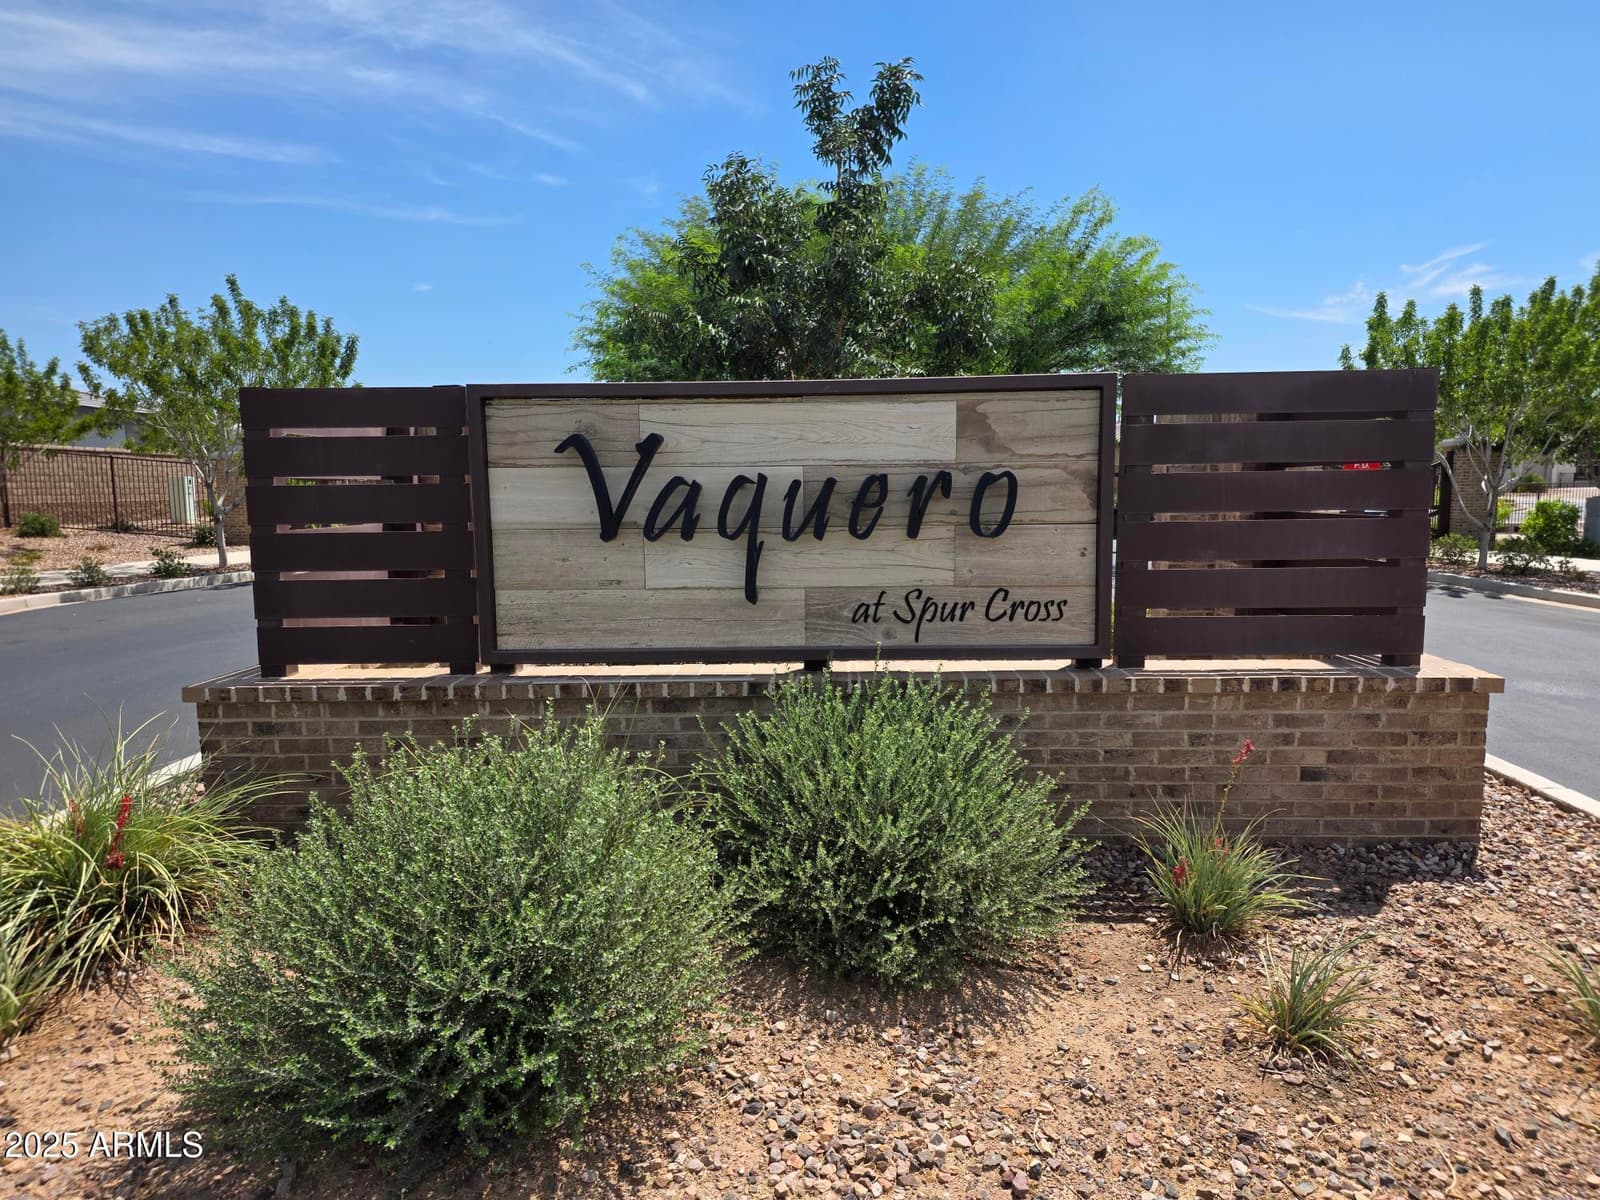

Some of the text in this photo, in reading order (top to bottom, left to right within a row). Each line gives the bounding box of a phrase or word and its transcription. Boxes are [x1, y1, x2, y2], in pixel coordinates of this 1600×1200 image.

[554, 433, 1018, 605] Vaquero
[852, 587, 1068, 643] at Spur Cross
